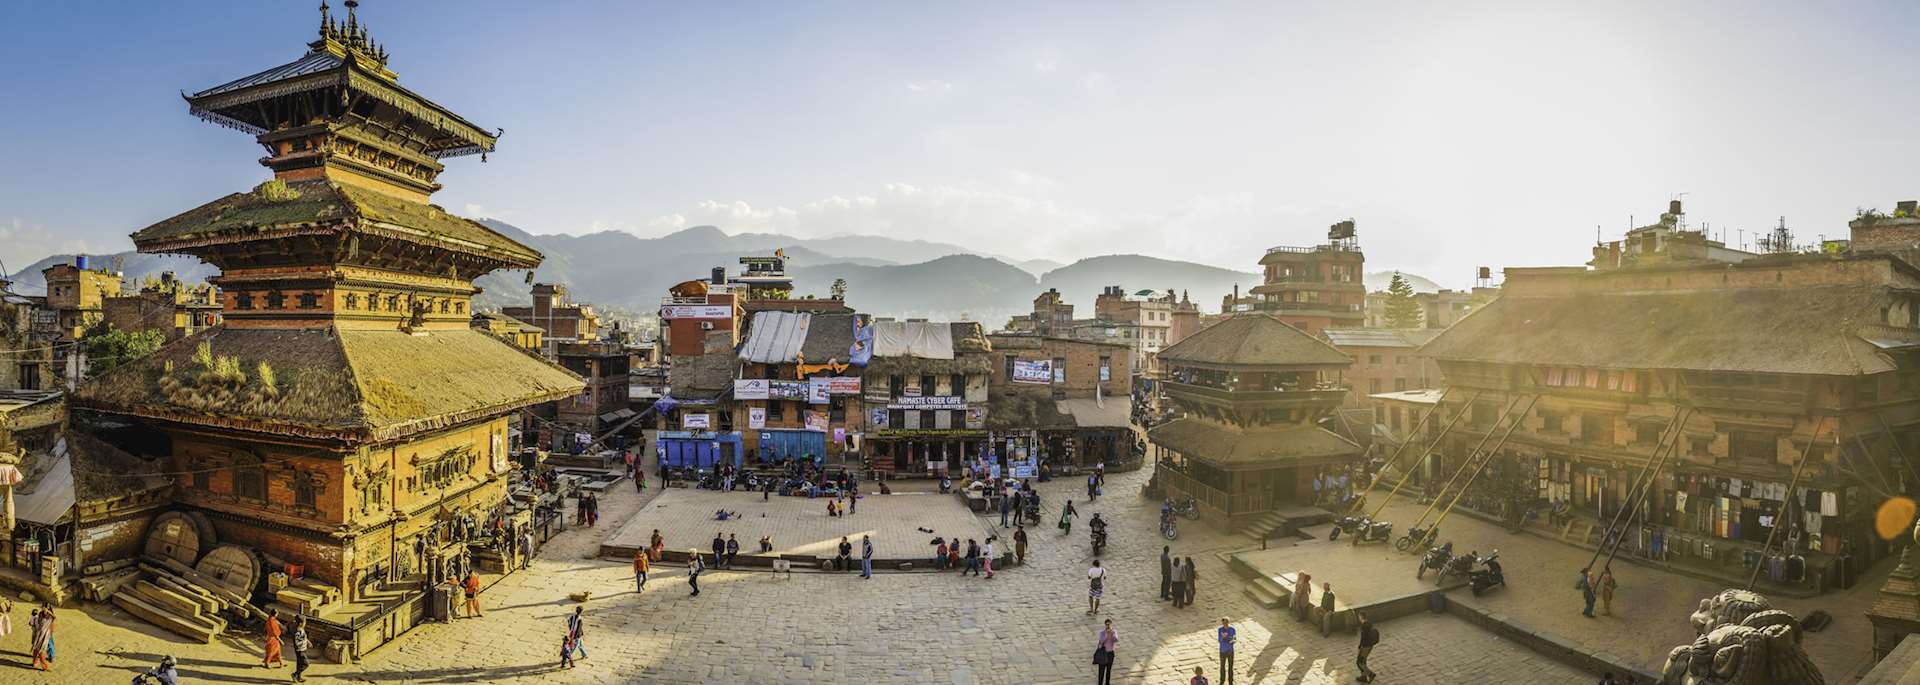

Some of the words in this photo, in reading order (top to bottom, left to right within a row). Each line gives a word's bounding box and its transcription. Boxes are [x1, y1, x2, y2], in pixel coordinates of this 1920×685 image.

[898, 396, 925, 404] NAMASTE
[927, 396, 945, 404] CYBER
[946, 396, 961, 404] CAFE
